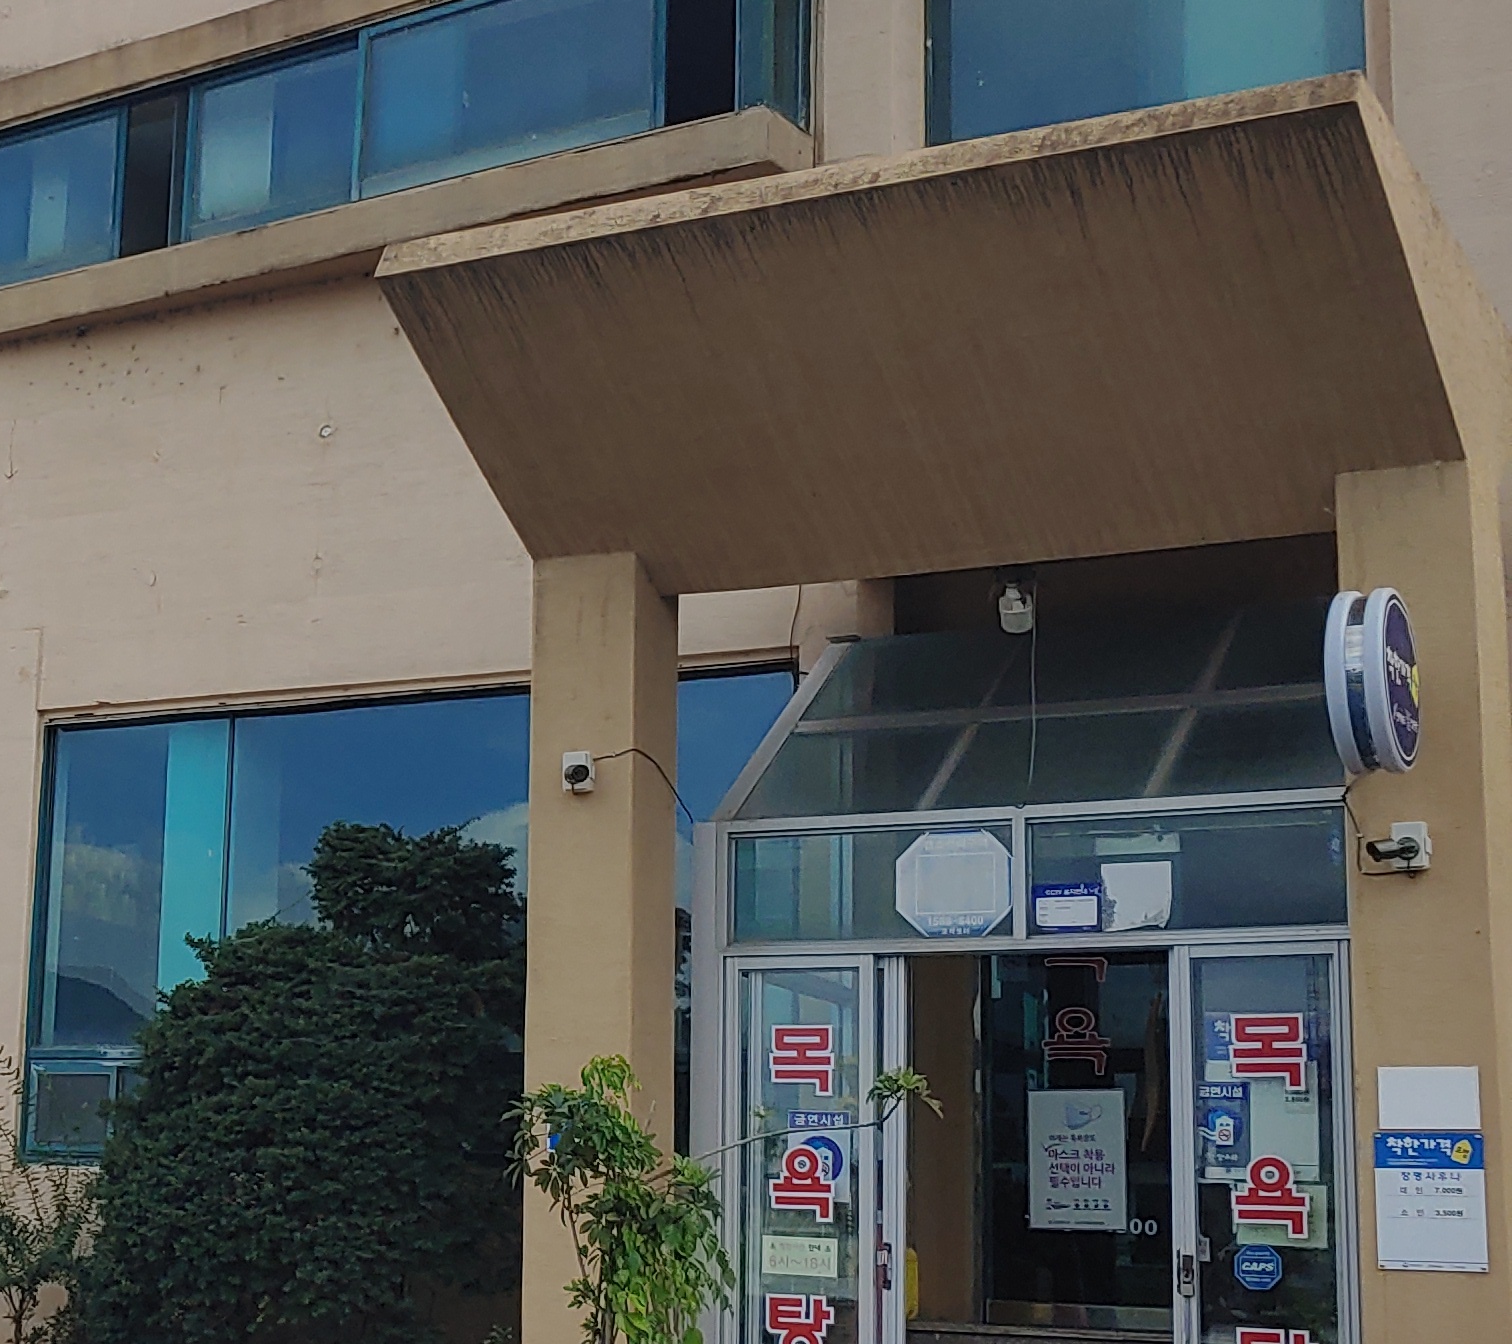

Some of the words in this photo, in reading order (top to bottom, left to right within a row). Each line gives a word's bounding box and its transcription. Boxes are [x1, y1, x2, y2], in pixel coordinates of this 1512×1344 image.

[1199, 1085, 1243, 1098] 금연시설
[1385, 1136, 1452, 1157] 착한가격
[1048, 1148, 1080, 1160] 마스크
[1083, 1148, 1105, 1160] 착용
[1049, 1162, 1080, 1175] 선택이
[1083, 1162, 1115, 1175] 아니라
[1049, 1176, 1102, 1189] 필수입니다
[1241, 1261, 1275, 1272] CAPS
